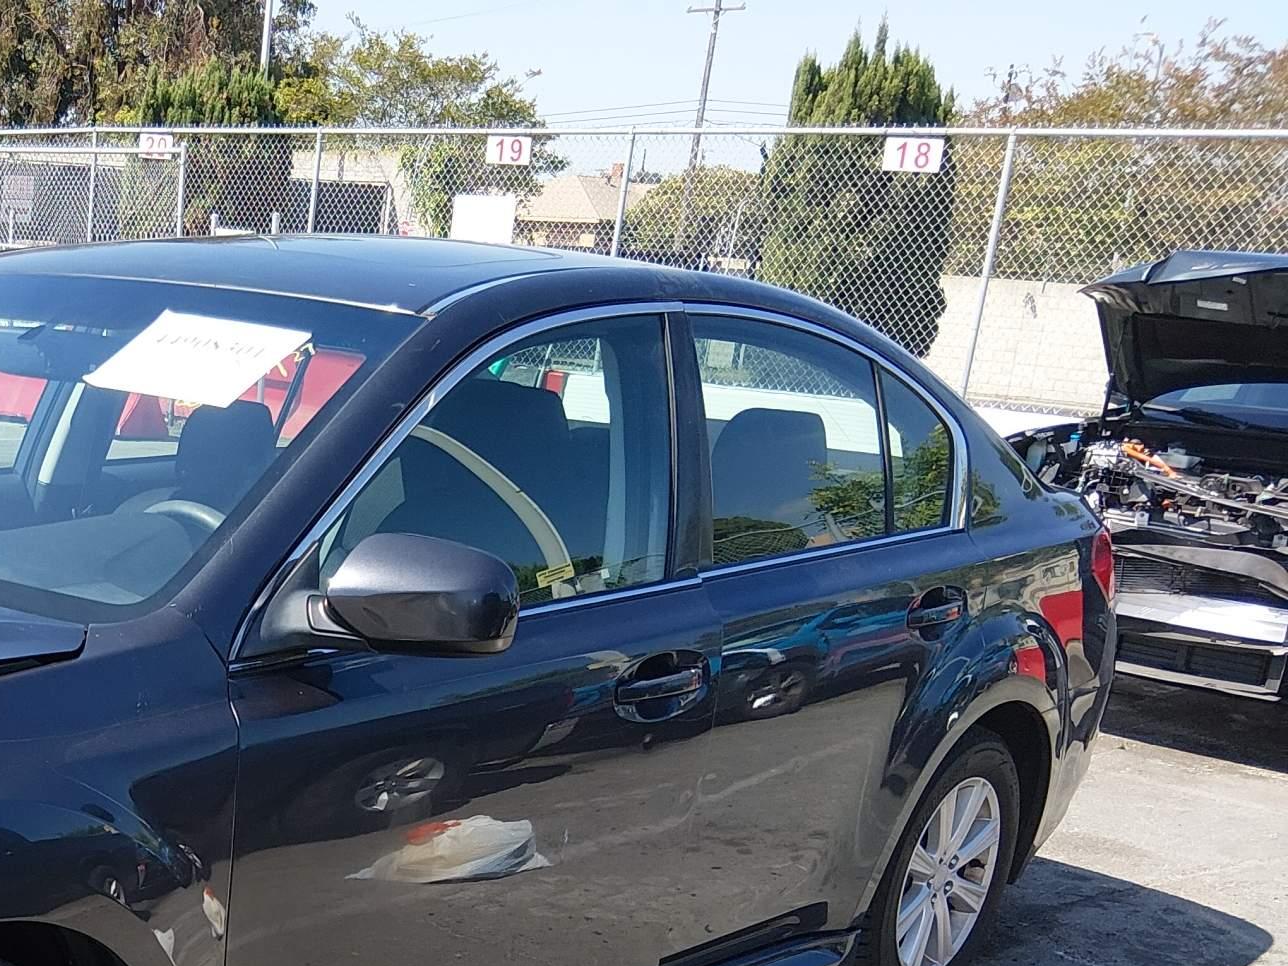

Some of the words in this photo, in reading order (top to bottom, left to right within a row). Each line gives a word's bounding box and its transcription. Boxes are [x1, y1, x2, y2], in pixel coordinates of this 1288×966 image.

[145, 136, 167, 157] 20
[495, 138, 523, 162] 19
[896, 141, 931, 169] 18
